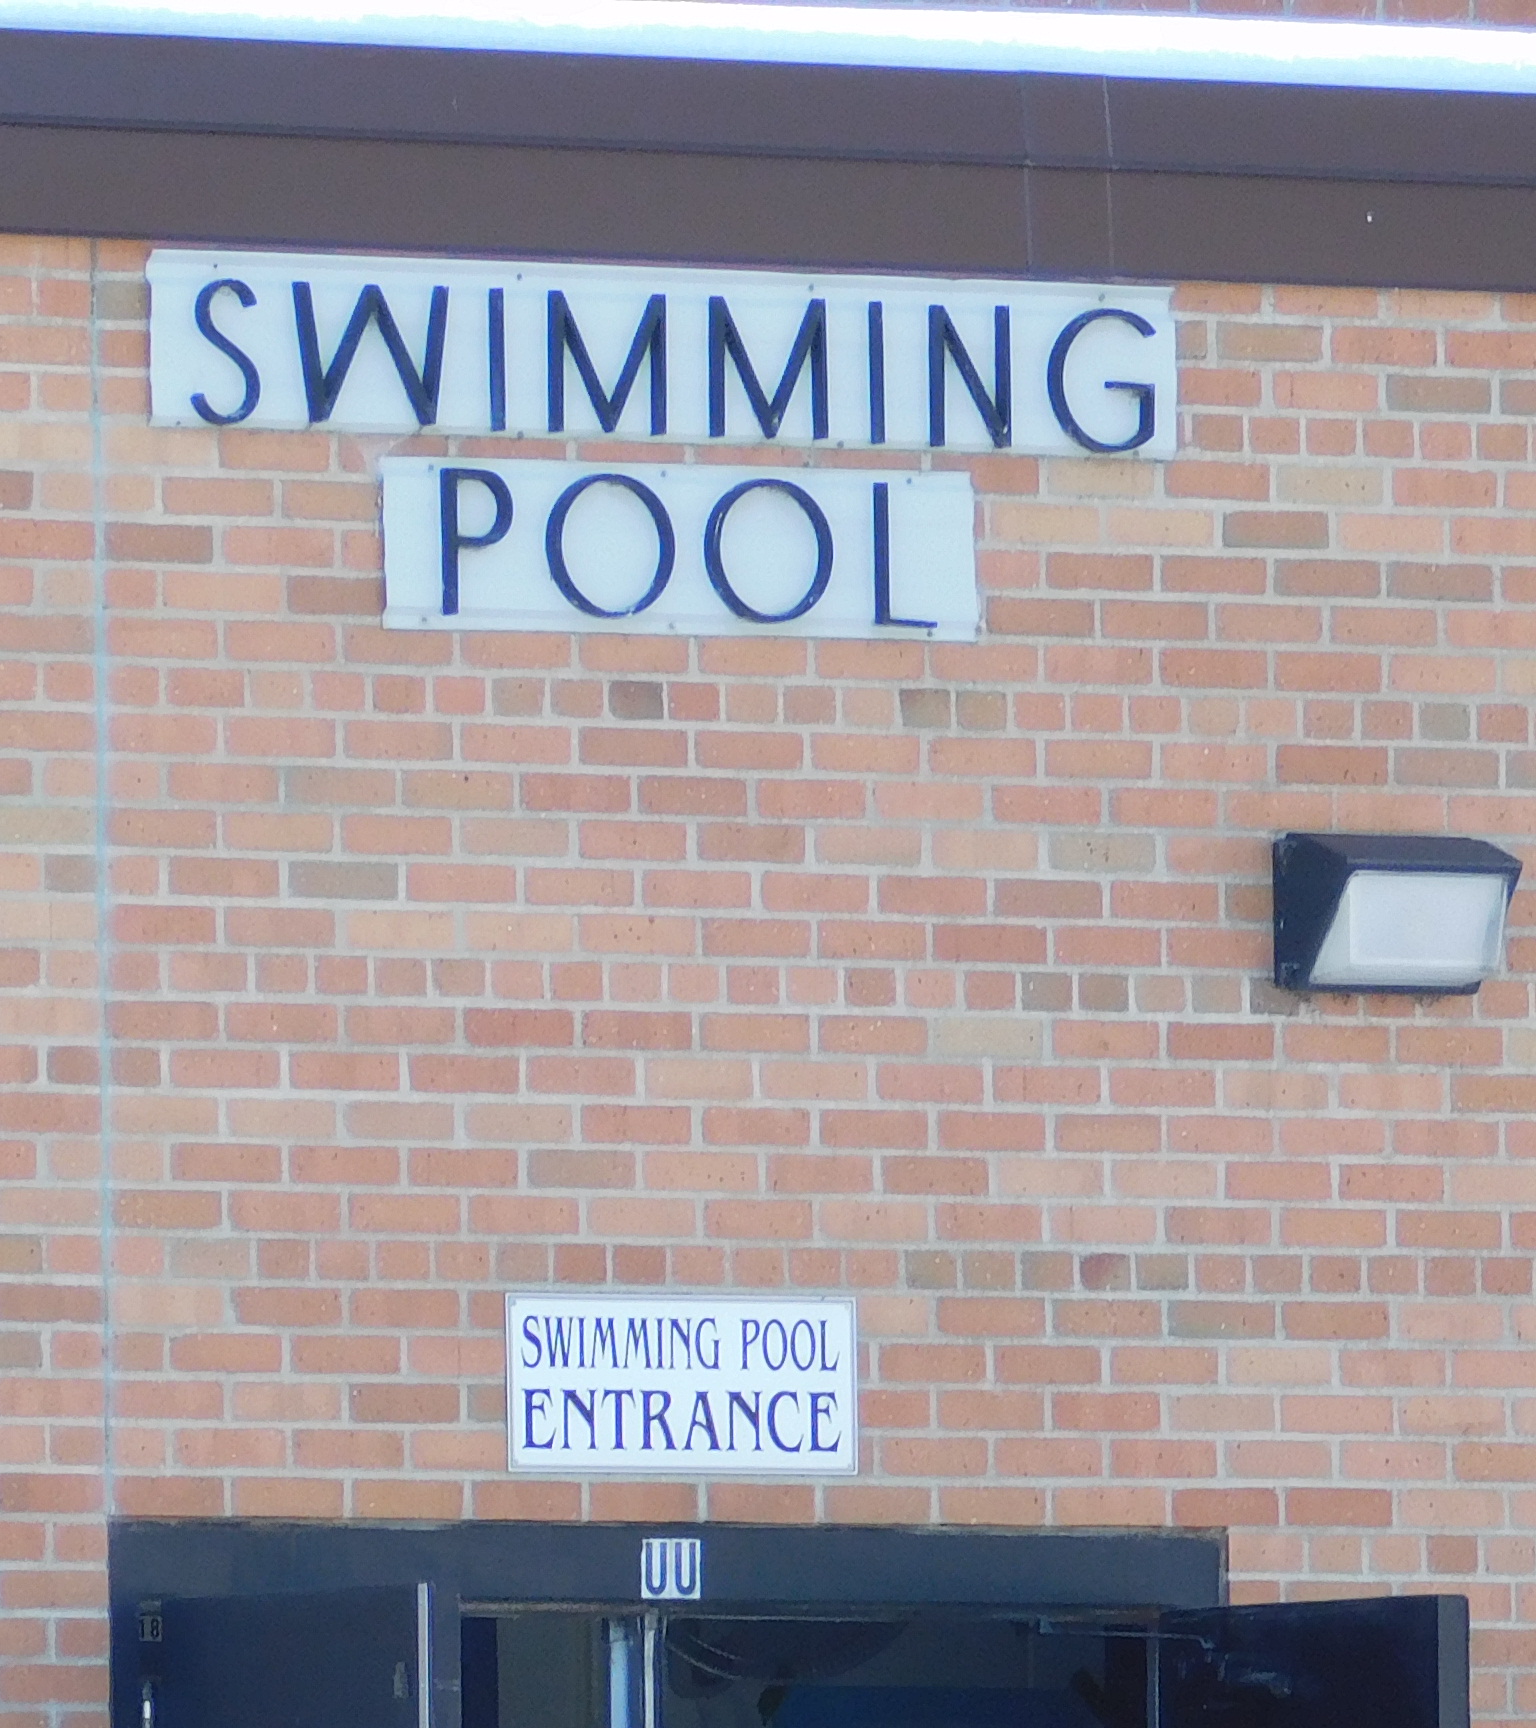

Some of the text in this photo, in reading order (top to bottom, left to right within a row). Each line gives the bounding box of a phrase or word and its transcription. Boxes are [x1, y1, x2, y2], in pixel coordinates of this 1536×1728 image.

[190, 278, 1157, 454] SWIMMING
[439, 466, 938, 627] POOL
[521, 1314, 840, 1372] SWIMMING POOL
[521, 1388, 842, 1453] ENTRANCE
